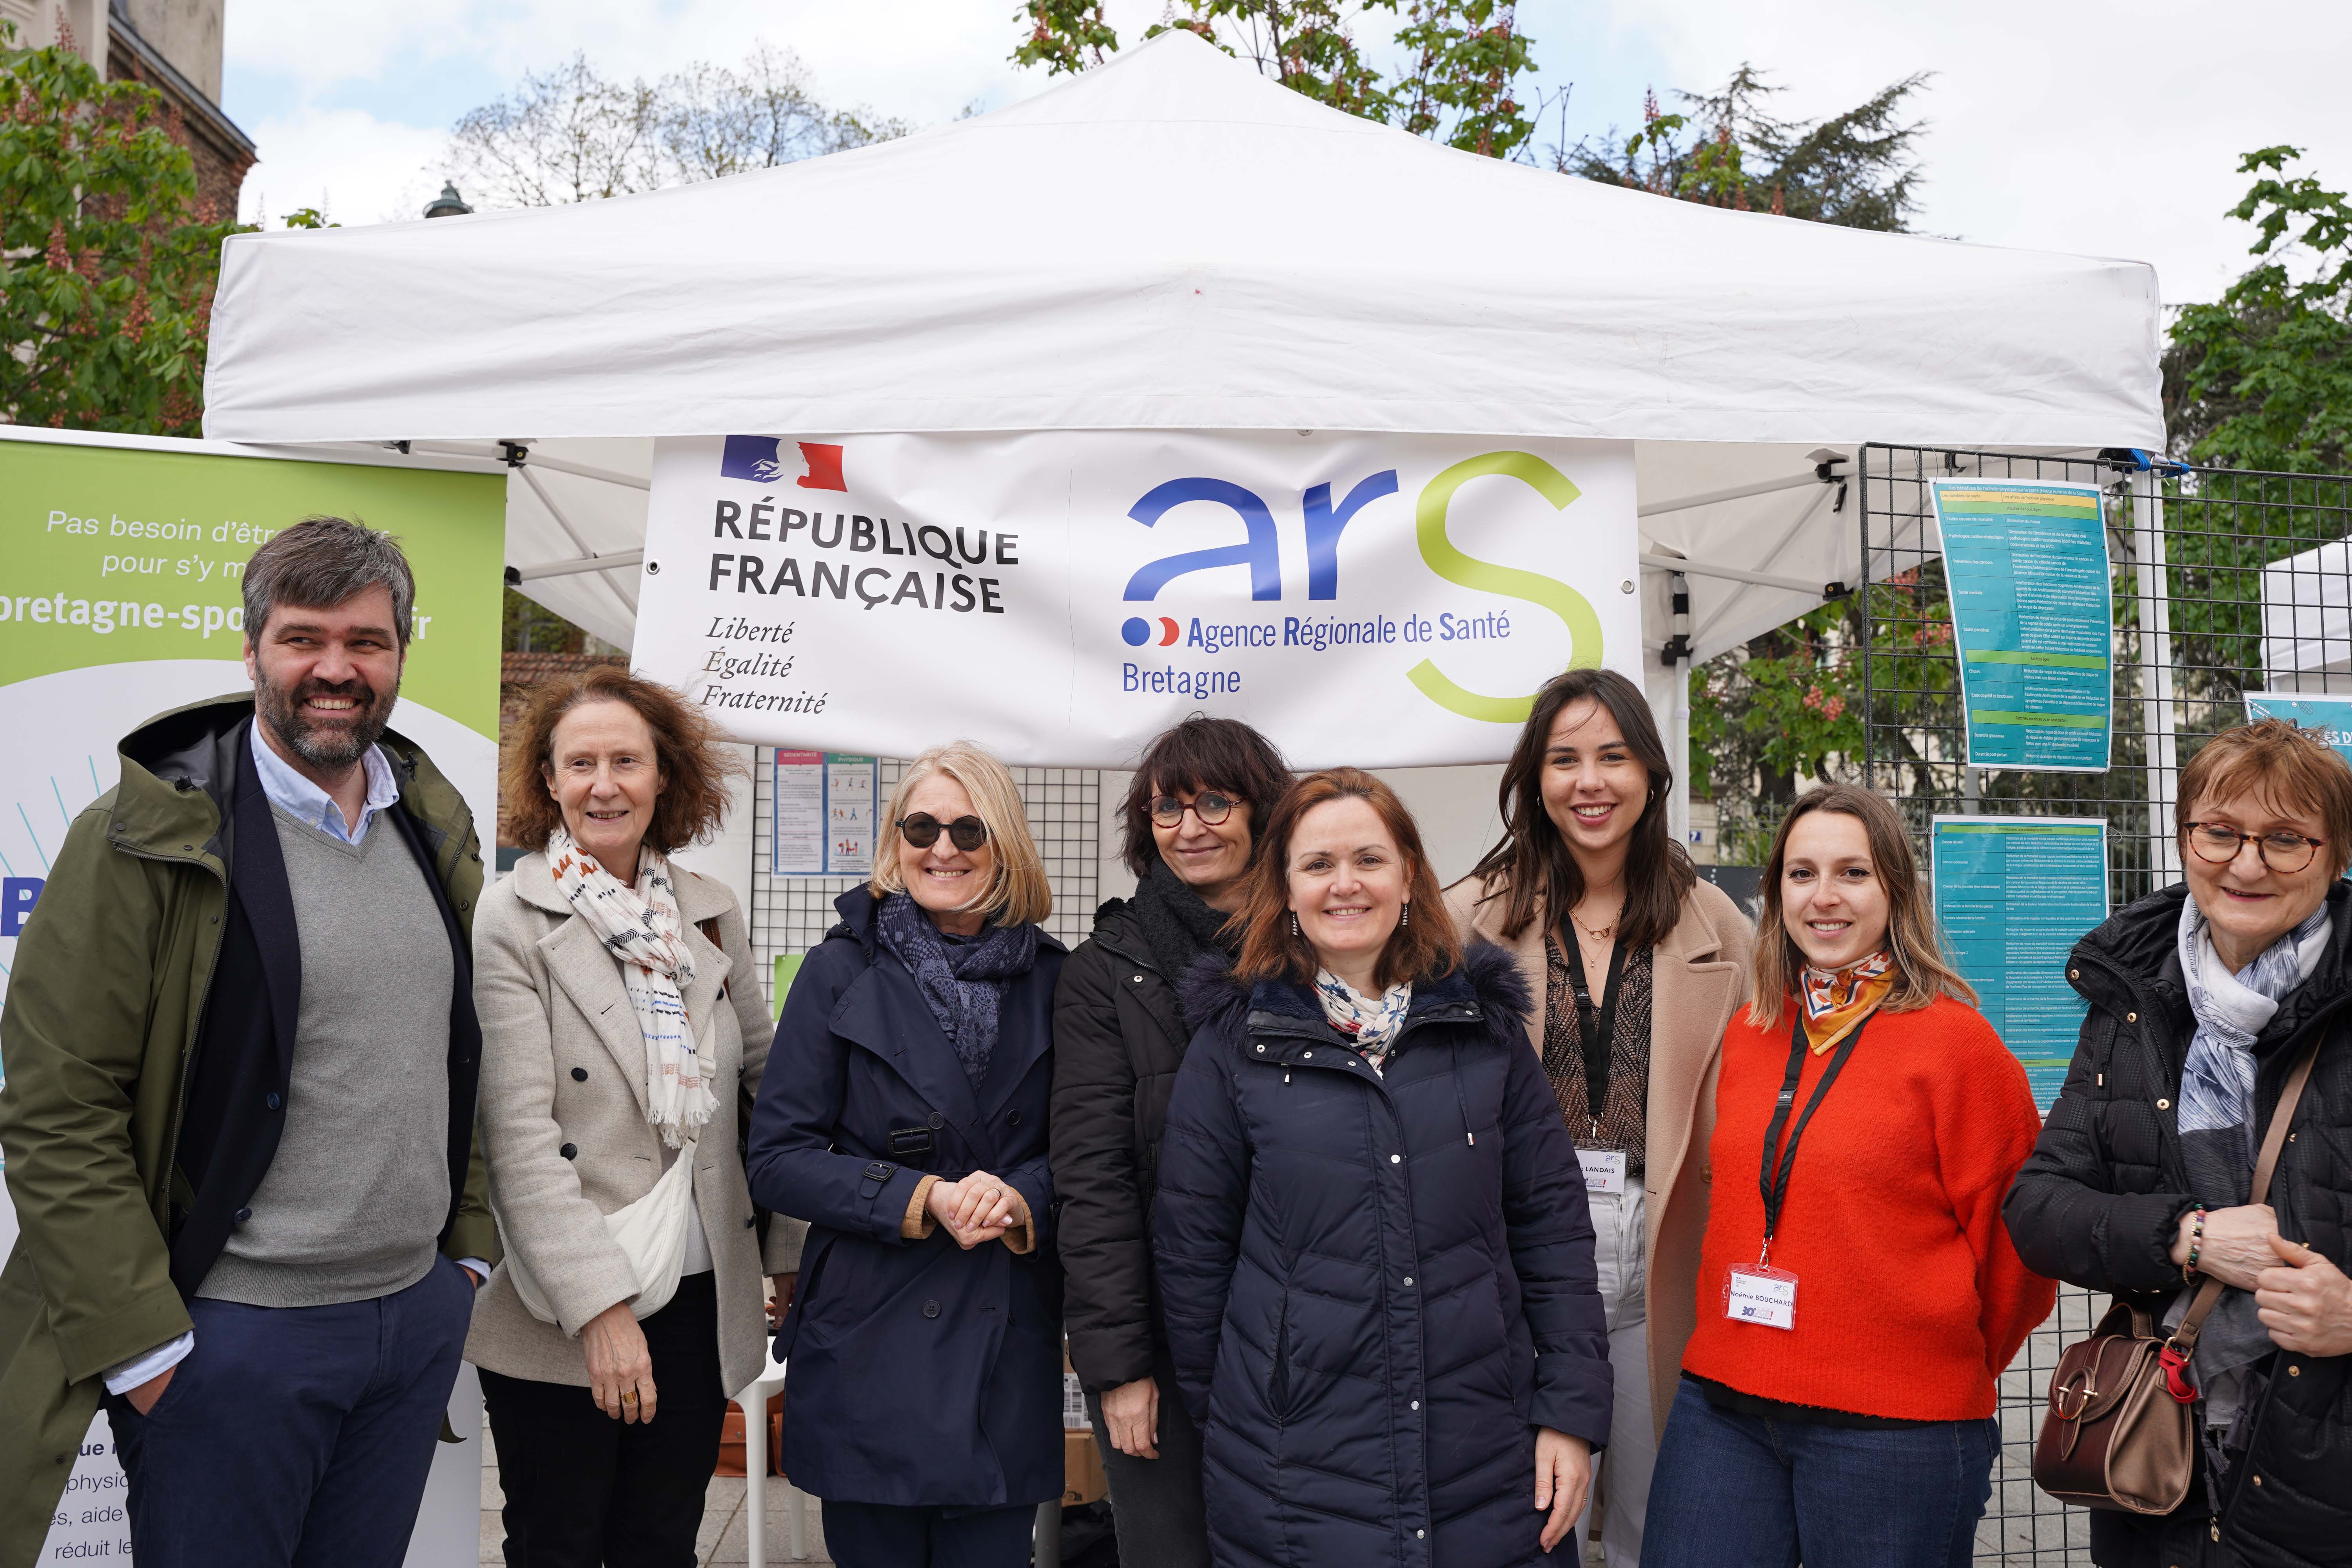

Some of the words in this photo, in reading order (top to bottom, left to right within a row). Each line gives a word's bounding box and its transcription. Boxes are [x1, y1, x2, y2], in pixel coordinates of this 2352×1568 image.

[47, 510, 99, 535] Pas
[110, 515, 201, 541] besoin
[212, 521, 281, 544] d'êtr
[714, 496, 1018, 568] RÉPUBLIQUE
[102, 555, 167, 577] pour
[176, 554, 215, 582] s'y
[709, 554, 1004, 613] FRANÇAISE
[1123, 451, 1604, 723] ars
[705, 617, 795, 643] Liberté
[1187, 616, 1276, 654] Agence
[1283, 614, 1396, 652] Régionale
[1403, 613, 1433, 642] de
[1440, 609, 1511, 641] Santé
[701, 646, 794, 679] Égalité
[1123, 662, 1241, 700] Bretagne
[700, 685, 828, 715] Fraternité
[1730, 1290, 1753, 1300] Noémie
[1755, 1295, 1793, 1307] BOUCHARD
[82, 1506, 123, 1523] aide
[55, 1540, 110, 1559] réduit
